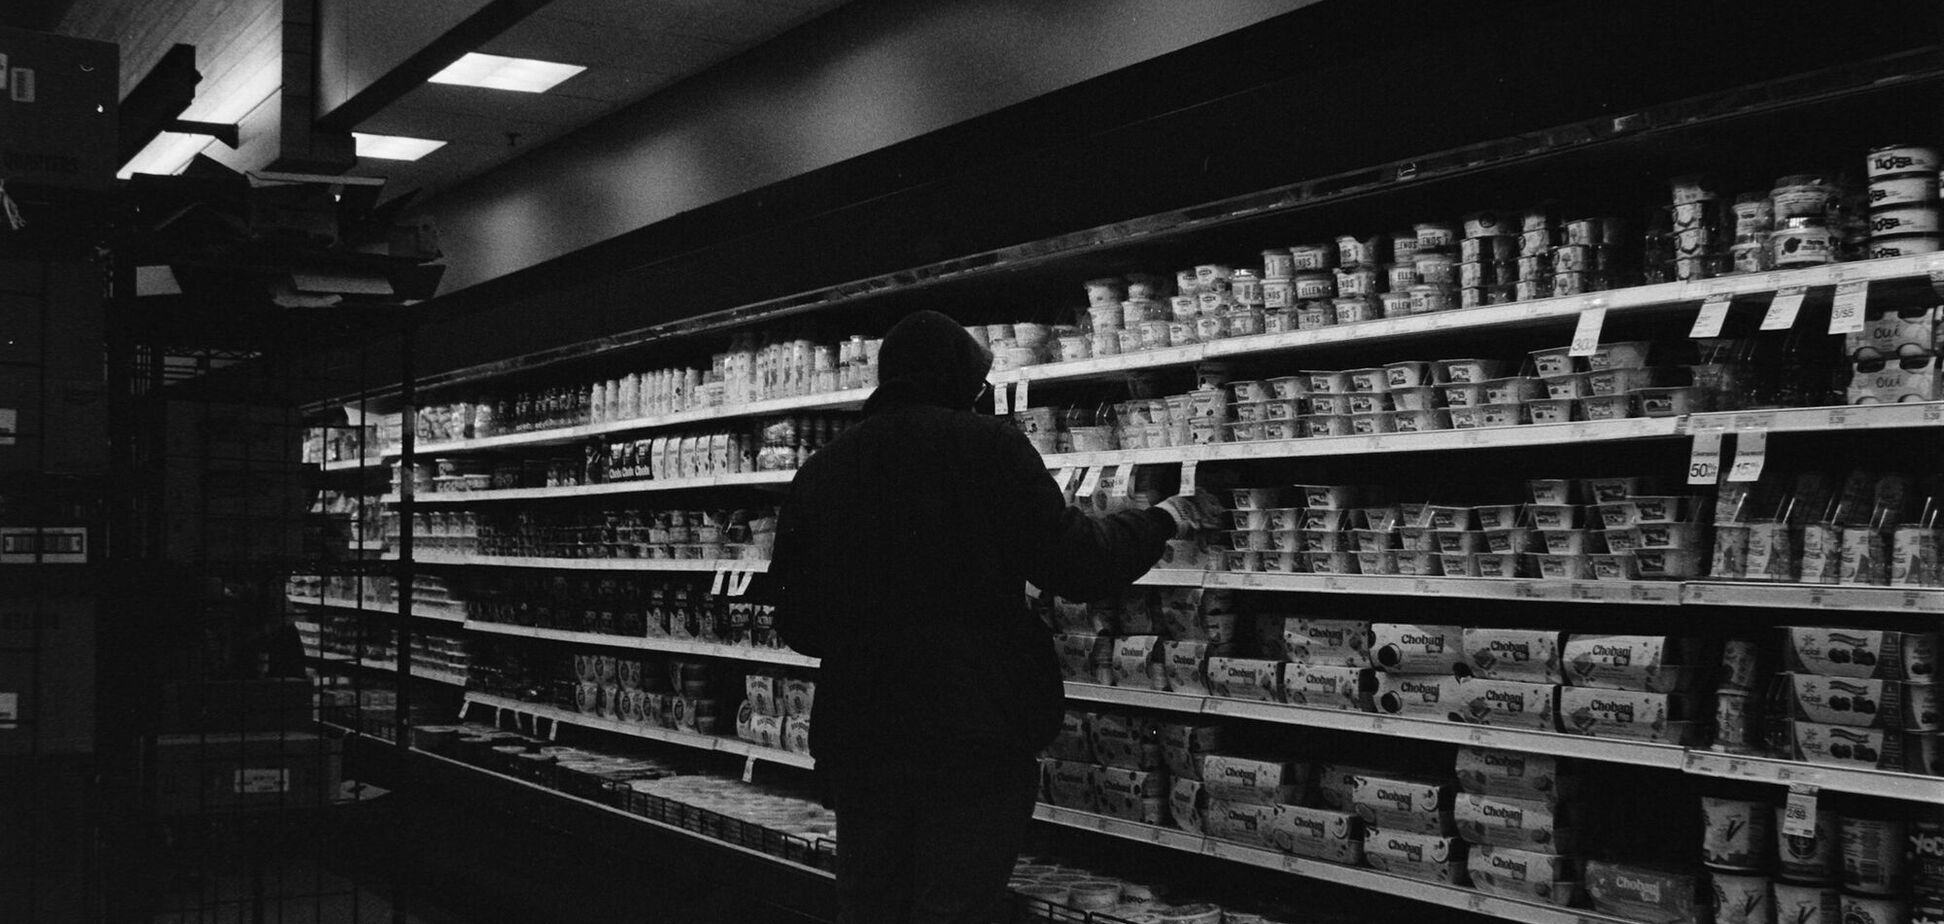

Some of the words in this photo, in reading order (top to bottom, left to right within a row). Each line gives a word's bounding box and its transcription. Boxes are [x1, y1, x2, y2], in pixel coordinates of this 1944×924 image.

[1875, 156, 1914, 170] noosa
[1401, 634, 1444, 647] Chobani
[1490, 640, 1528, 653] Chobani
[1592, 644, 1632, 657] Chobani
[1401, 681, 1440, 695] Chobani
[1486, 689, 1523, 703] Chobani
[1591, 699, 1634, 714] Chobani
[1484, 754, 1525, 769] Chobani
[1377, 789, 1412, 803] Chobani
[1483, 804, 1523, 820] Chobani
[1492, 855, 1527, 872] Chobani
[1616, 876, 1660, 893] Chobani
